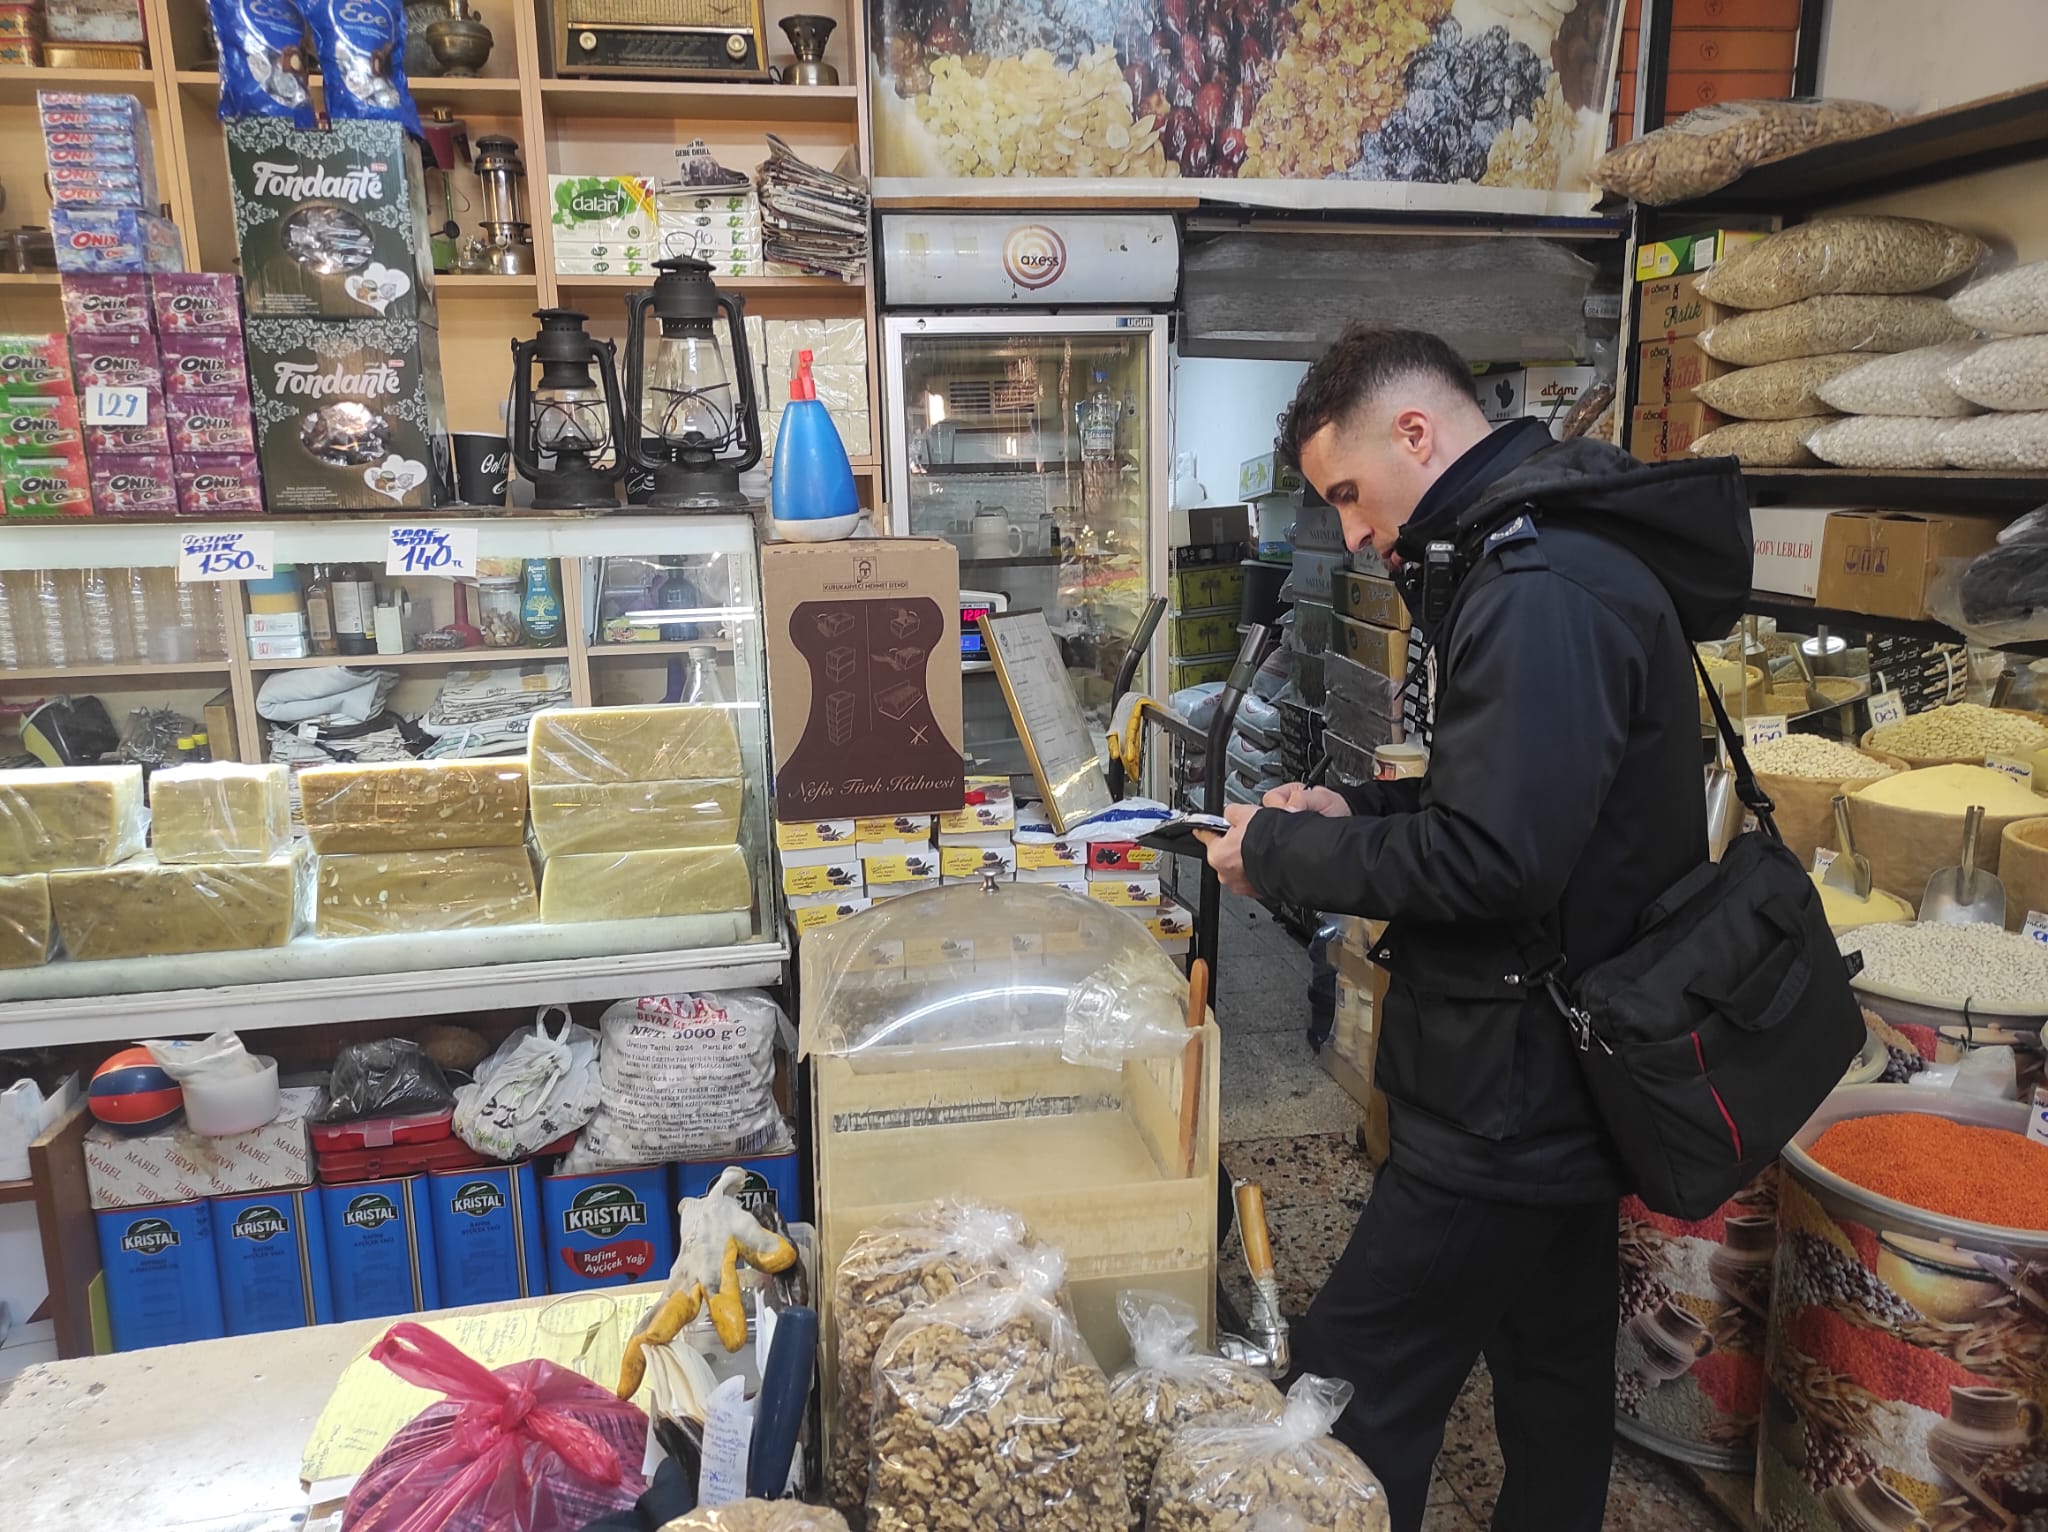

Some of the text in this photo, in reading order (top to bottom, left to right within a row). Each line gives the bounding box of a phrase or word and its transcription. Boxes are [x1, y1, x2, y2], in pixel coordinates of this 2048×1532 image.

[339, 2, 387, 28] Ece
[47, 112, 90, 124] ONIX
[52, 131, 95, 144] ONIX
[53, 150, 95, 162] ONIX
[56, 168, 98, 180] ONIX
[59, 187, 102, 200] ONIX
[572, 192, 619, 212] dalan
[72, 231, 118, 248] ONIX
[1021, 253, 1060, 268] axess
[82, 295, 128, 311] ONIX
[172, 296, 217, 312] ONIX
[2, 355, 48, 371] ONIX
[93, 356, 138, 372] ONIX
[180, 356, 226, 372] ONIX
[12, 416, 59, 432] ONIX
[187, 415, 233, 431] ONIX
[21, 477, 68, 493] ONIX
[110, 474, 157, 491] ONIX
[194, 474, 240, 490] ONIX
[199, 550, 255, 575] 150
[400, 544, 452, 572] 140
[788, 775, 956, 803] Nefis Türk Kahvesi
[236, 1141, 271, 1166] MABEL
[273, 1137, 308, 1161] MABEL
[87, 1153, 121, 1181] MABEL
[125, 1151, 161, 1178] MABEL
[454, 1196, 502, 1213] KRiSTAL
[345, 1207, 396, 1225] KRiSTAL
[569, 1205, 641, 1229] KRiSTAL
[235, 1220, 286, 1237] KRiSTAL
[125, 1233, 177, 1250] KRiSTAL
[584, 1250, 617, 1264] Rafine
[585, 1253, 647, 1274] Ayçiçek Yağı
